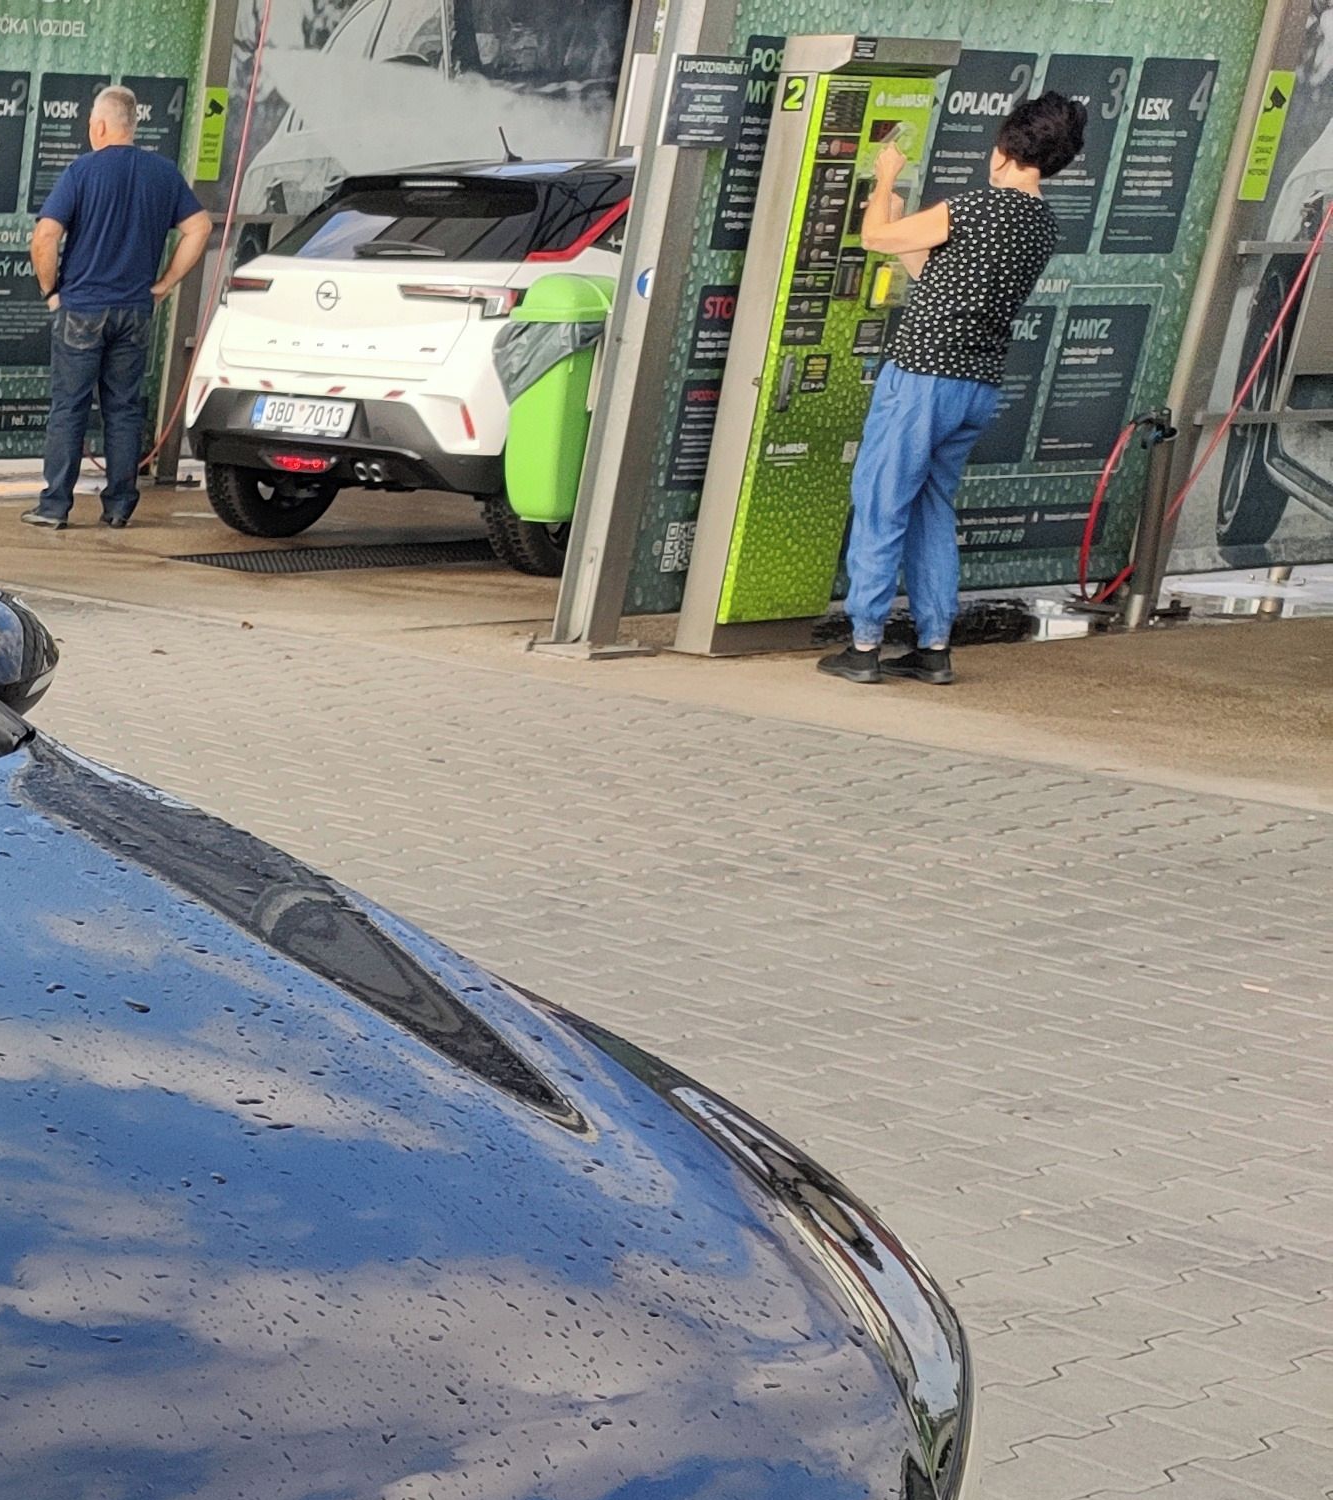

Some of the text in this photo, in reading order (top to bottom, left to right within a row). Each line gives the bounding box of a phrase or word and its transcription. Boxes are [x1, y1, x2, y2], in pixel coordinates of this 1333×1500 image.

[33, 17, 87, 37] VOZIDEL
[683, 60, 745, 75] UPOZORNĚNÍ
[751, 48, 784, 72] POS
[11, 78, 28, 116] 2
[167, 85, 183, 122] 4
[784, 78, 806, 110] 2
[948, 91, 1013, 116] OPLACH
[1102, 68, 1128, 120] 3
[1189, 70, 1213, 121] 4
[43, 101, 79, 119] VOSK
[1137, 97, 1173, 121] LESK
[1036, 279, 1070, 293] RAMY
[703, 296, 735, 319] STO
[1012, 313, 1043, 340] TÁČ
[1067, 318, 1112, 339] HMYZ
[266, 402, 344, 427] 3BD 7013
